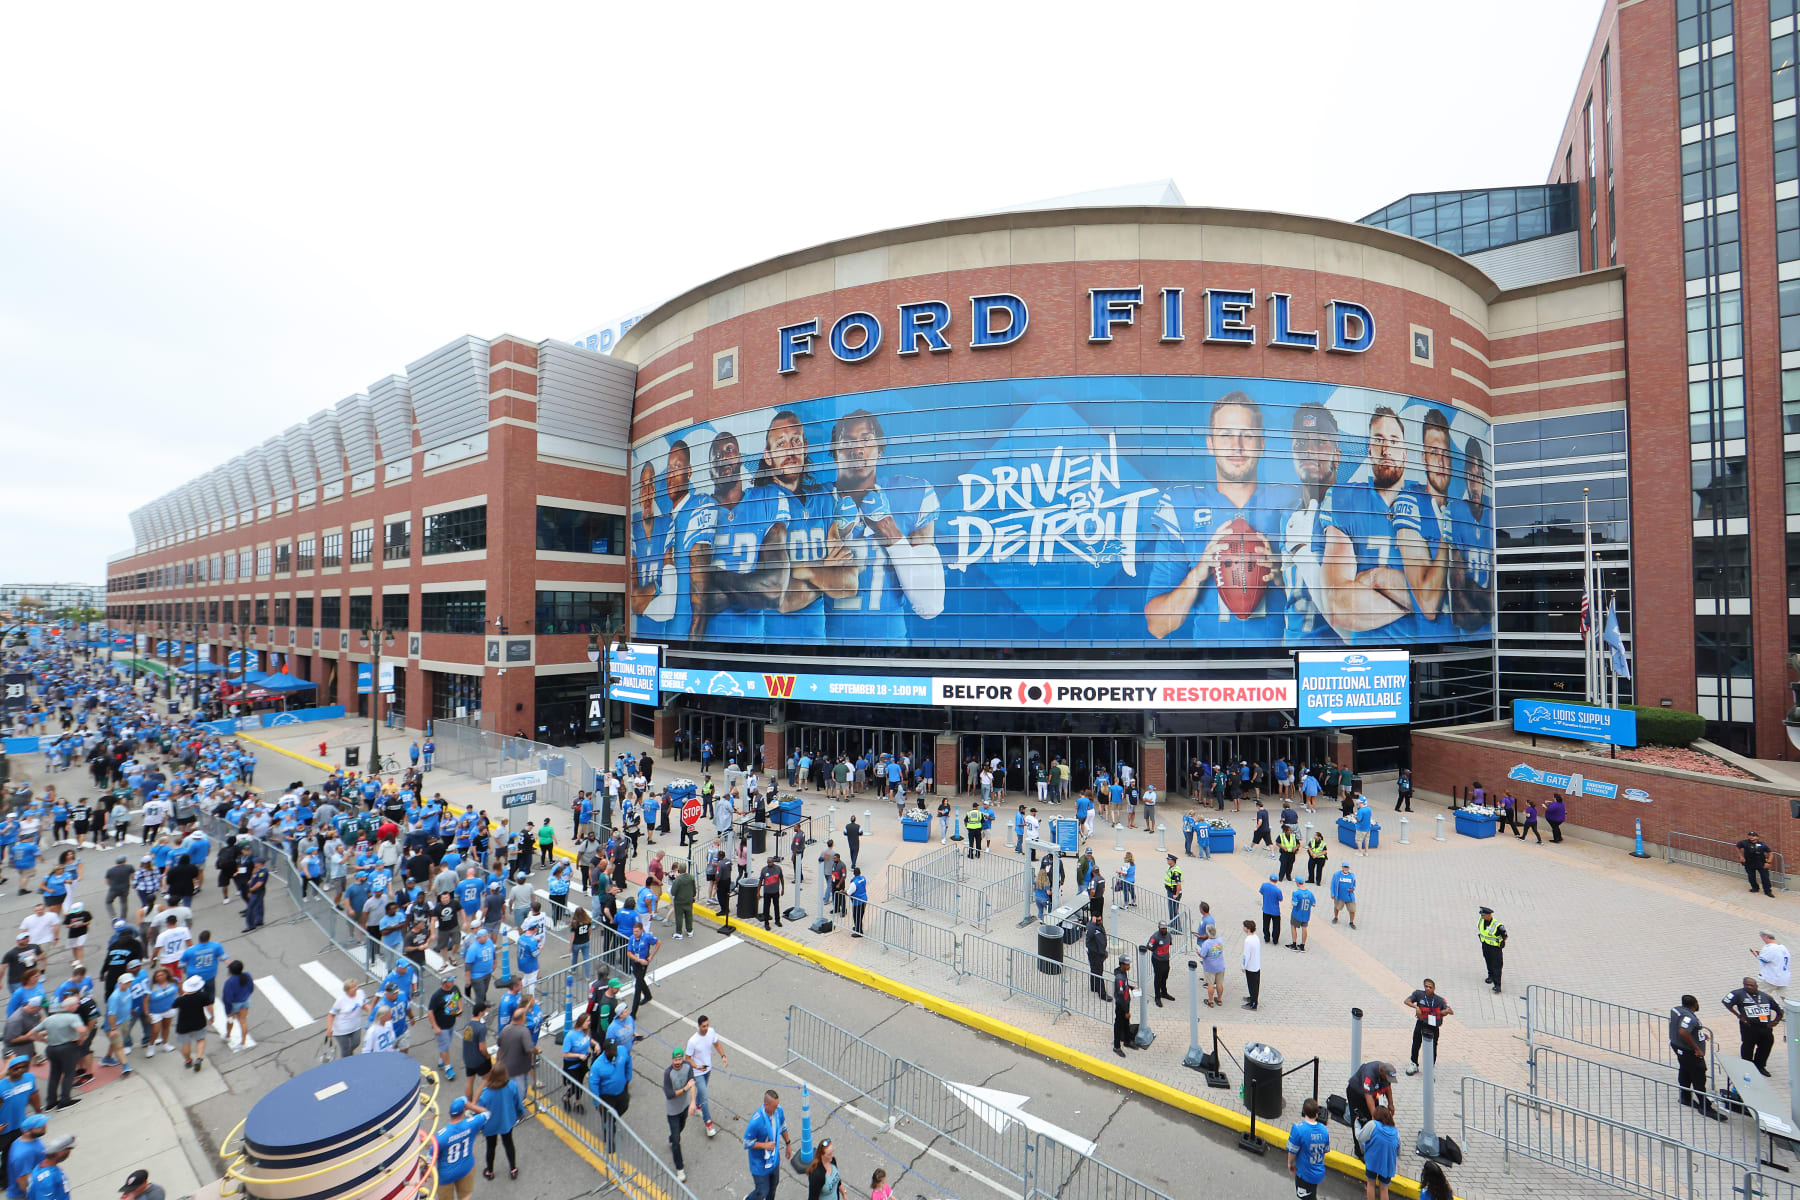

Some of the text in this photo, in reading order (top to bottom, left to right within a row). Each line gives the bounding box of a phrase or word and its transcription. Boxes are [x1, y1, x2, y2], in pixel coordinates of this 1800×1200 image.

[777, 285, 1376, 374] FORD FIELD
[958, 432, 1121, 512] DRIVEN
[1068, 487, 1104, 516] BY
[947, 488, 1160, 577] DETROIT
[637, 665, 657, 677] ENTRY
[623, 677, 654, 691] AVAILABLE
[829, 682, 875, 695] SEPTEMBER
[877, 684, 887, 695] 18
[893, 684, 911, 696] 1:00
[913, 685, 927, 697] PM
[1302, 675, 1407, 690] ADDITIONAL ENTRY
[943, 684, 1287, 701] BELFOR PROPERTY RESTORATION
[1307, 692, 1402, 708] GATES AVAILABLE
[588, 700, 601, 719] A
[1553, 709, 1611, 726] LIONS SUPPLY
[1546, 773, 1583, 797] GATE A
[683, 806, 700, 819] STOP
[1744, 1004, 1770, 1018] LIONS
